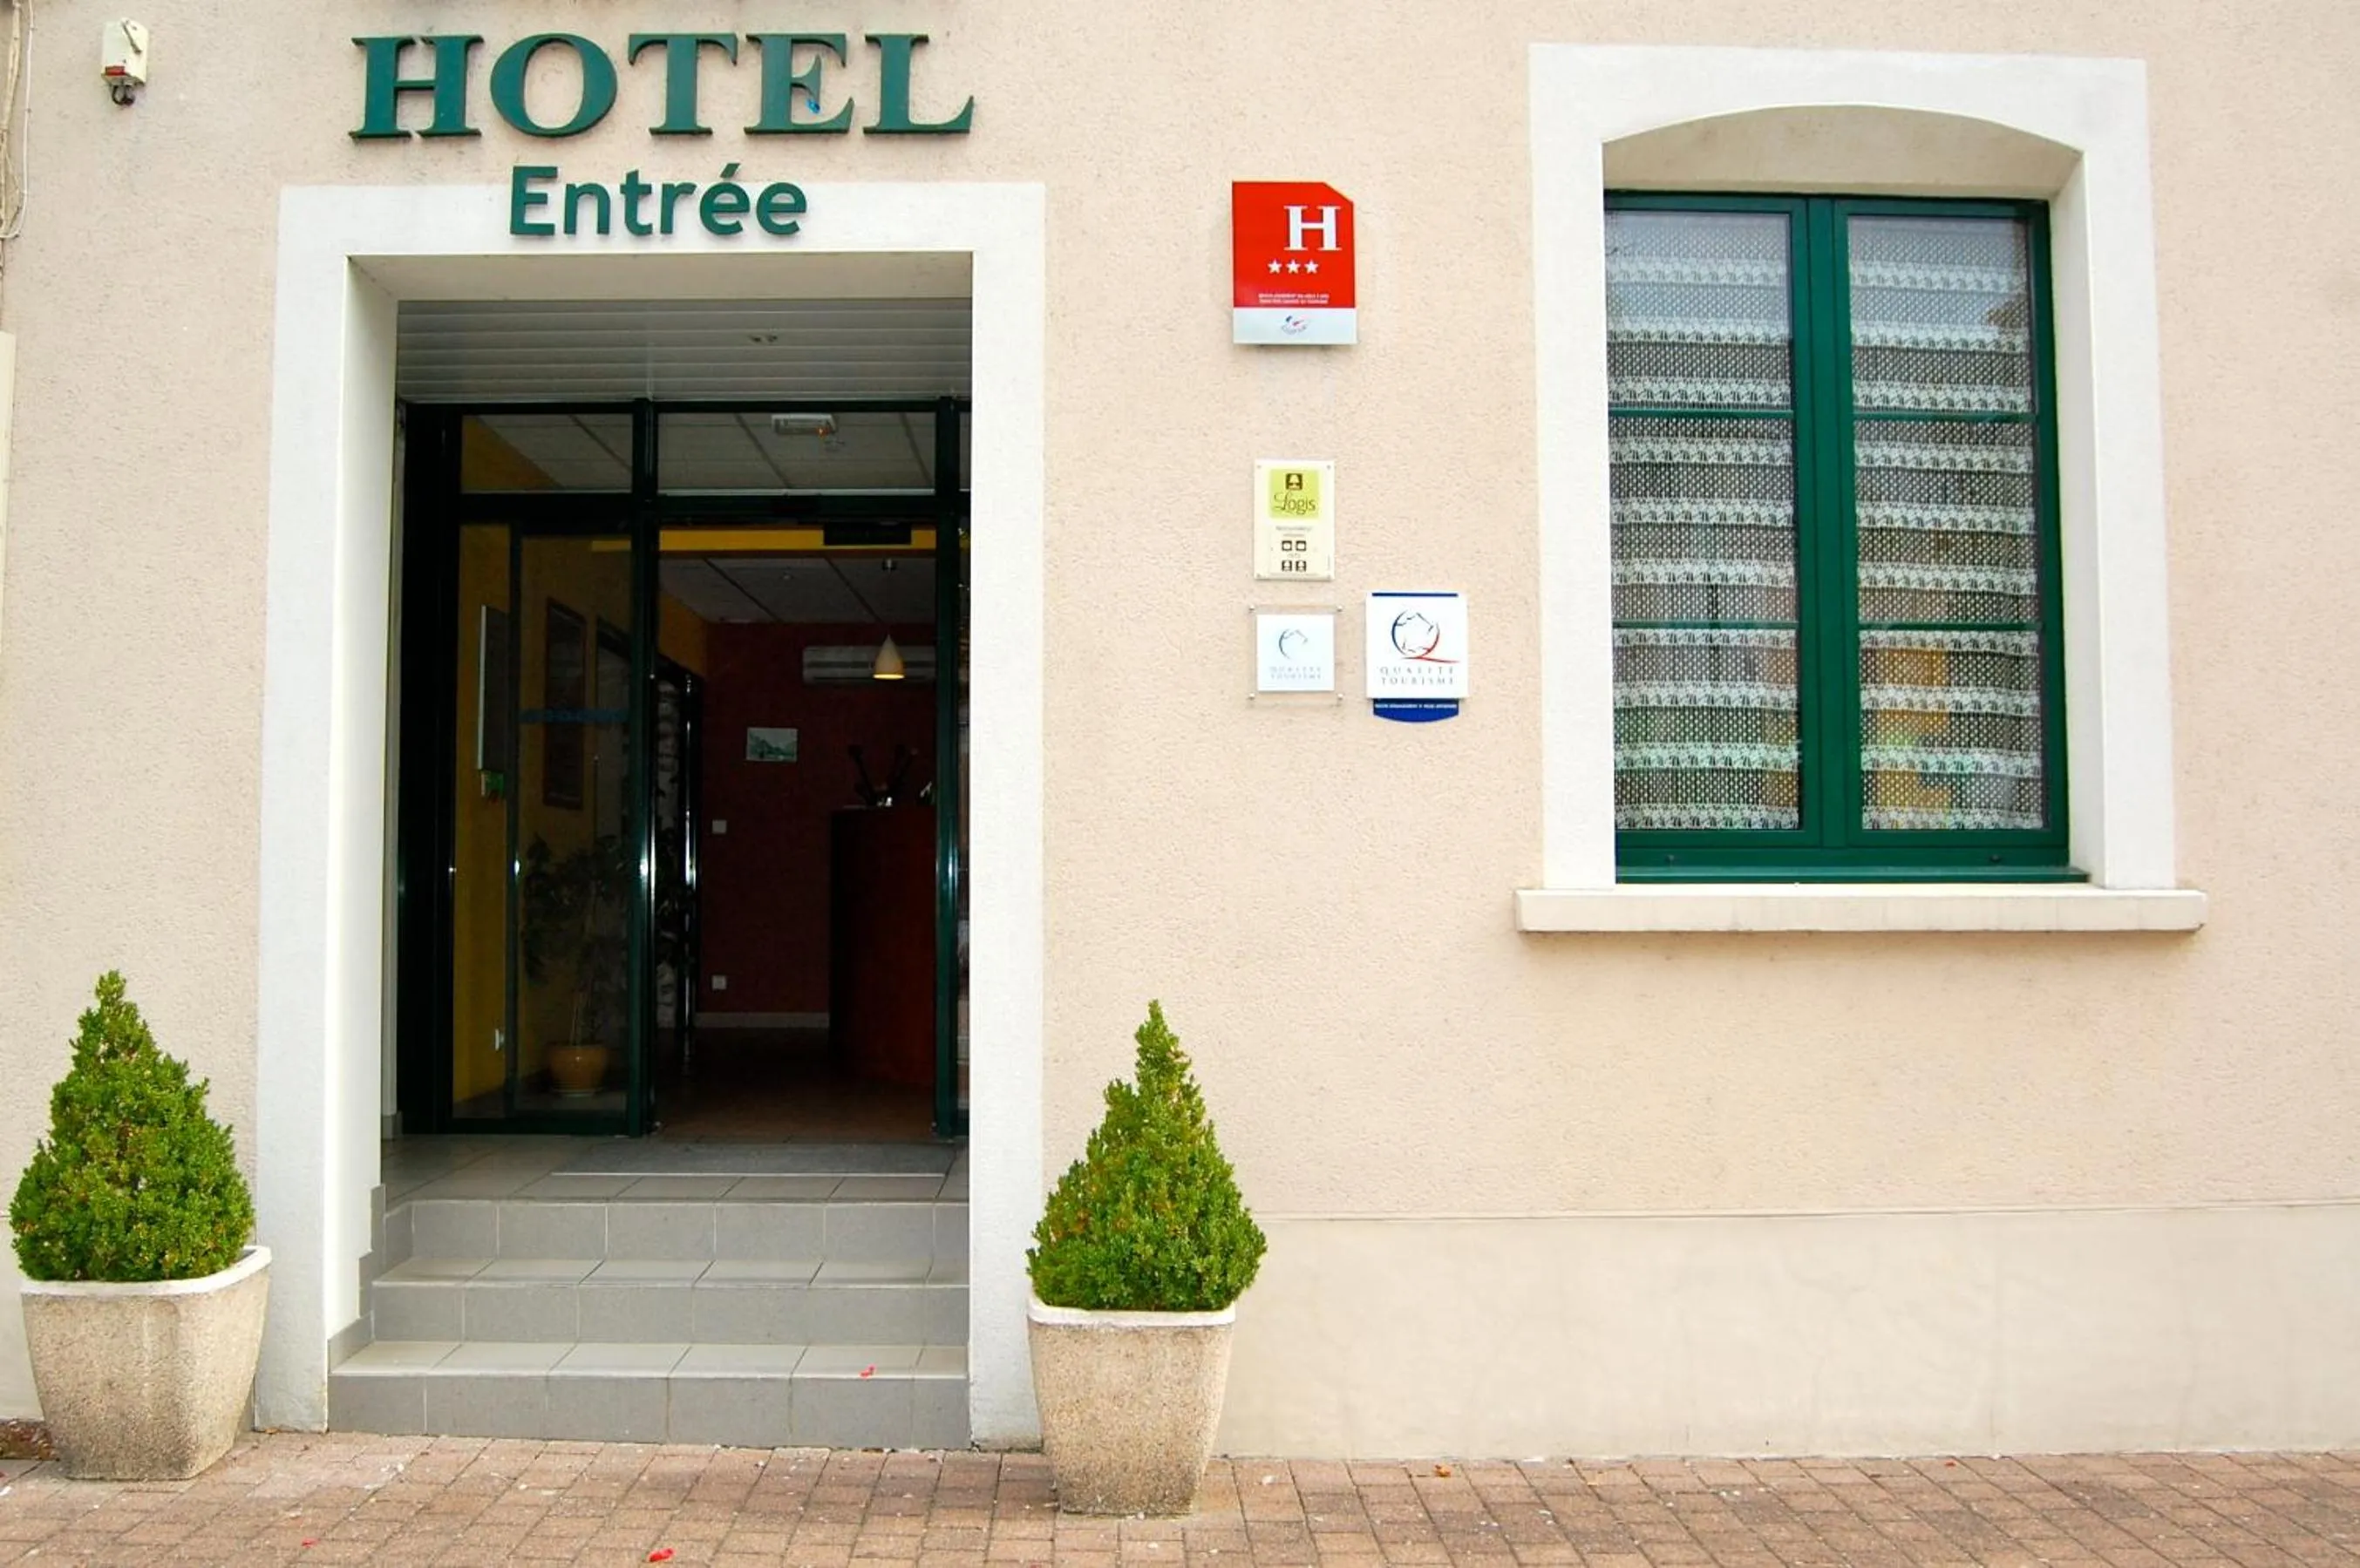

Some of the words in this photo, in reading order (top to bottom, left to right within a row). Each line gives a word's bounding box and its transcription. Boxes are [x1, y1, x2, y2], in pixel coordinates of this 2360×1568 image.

[349, 32, 975, 138] HOTEL
[510, 163, 807, 236] Entrée
[1283, 205, 1343, 251] H
[1273, 491, 1316, 515] Logis
